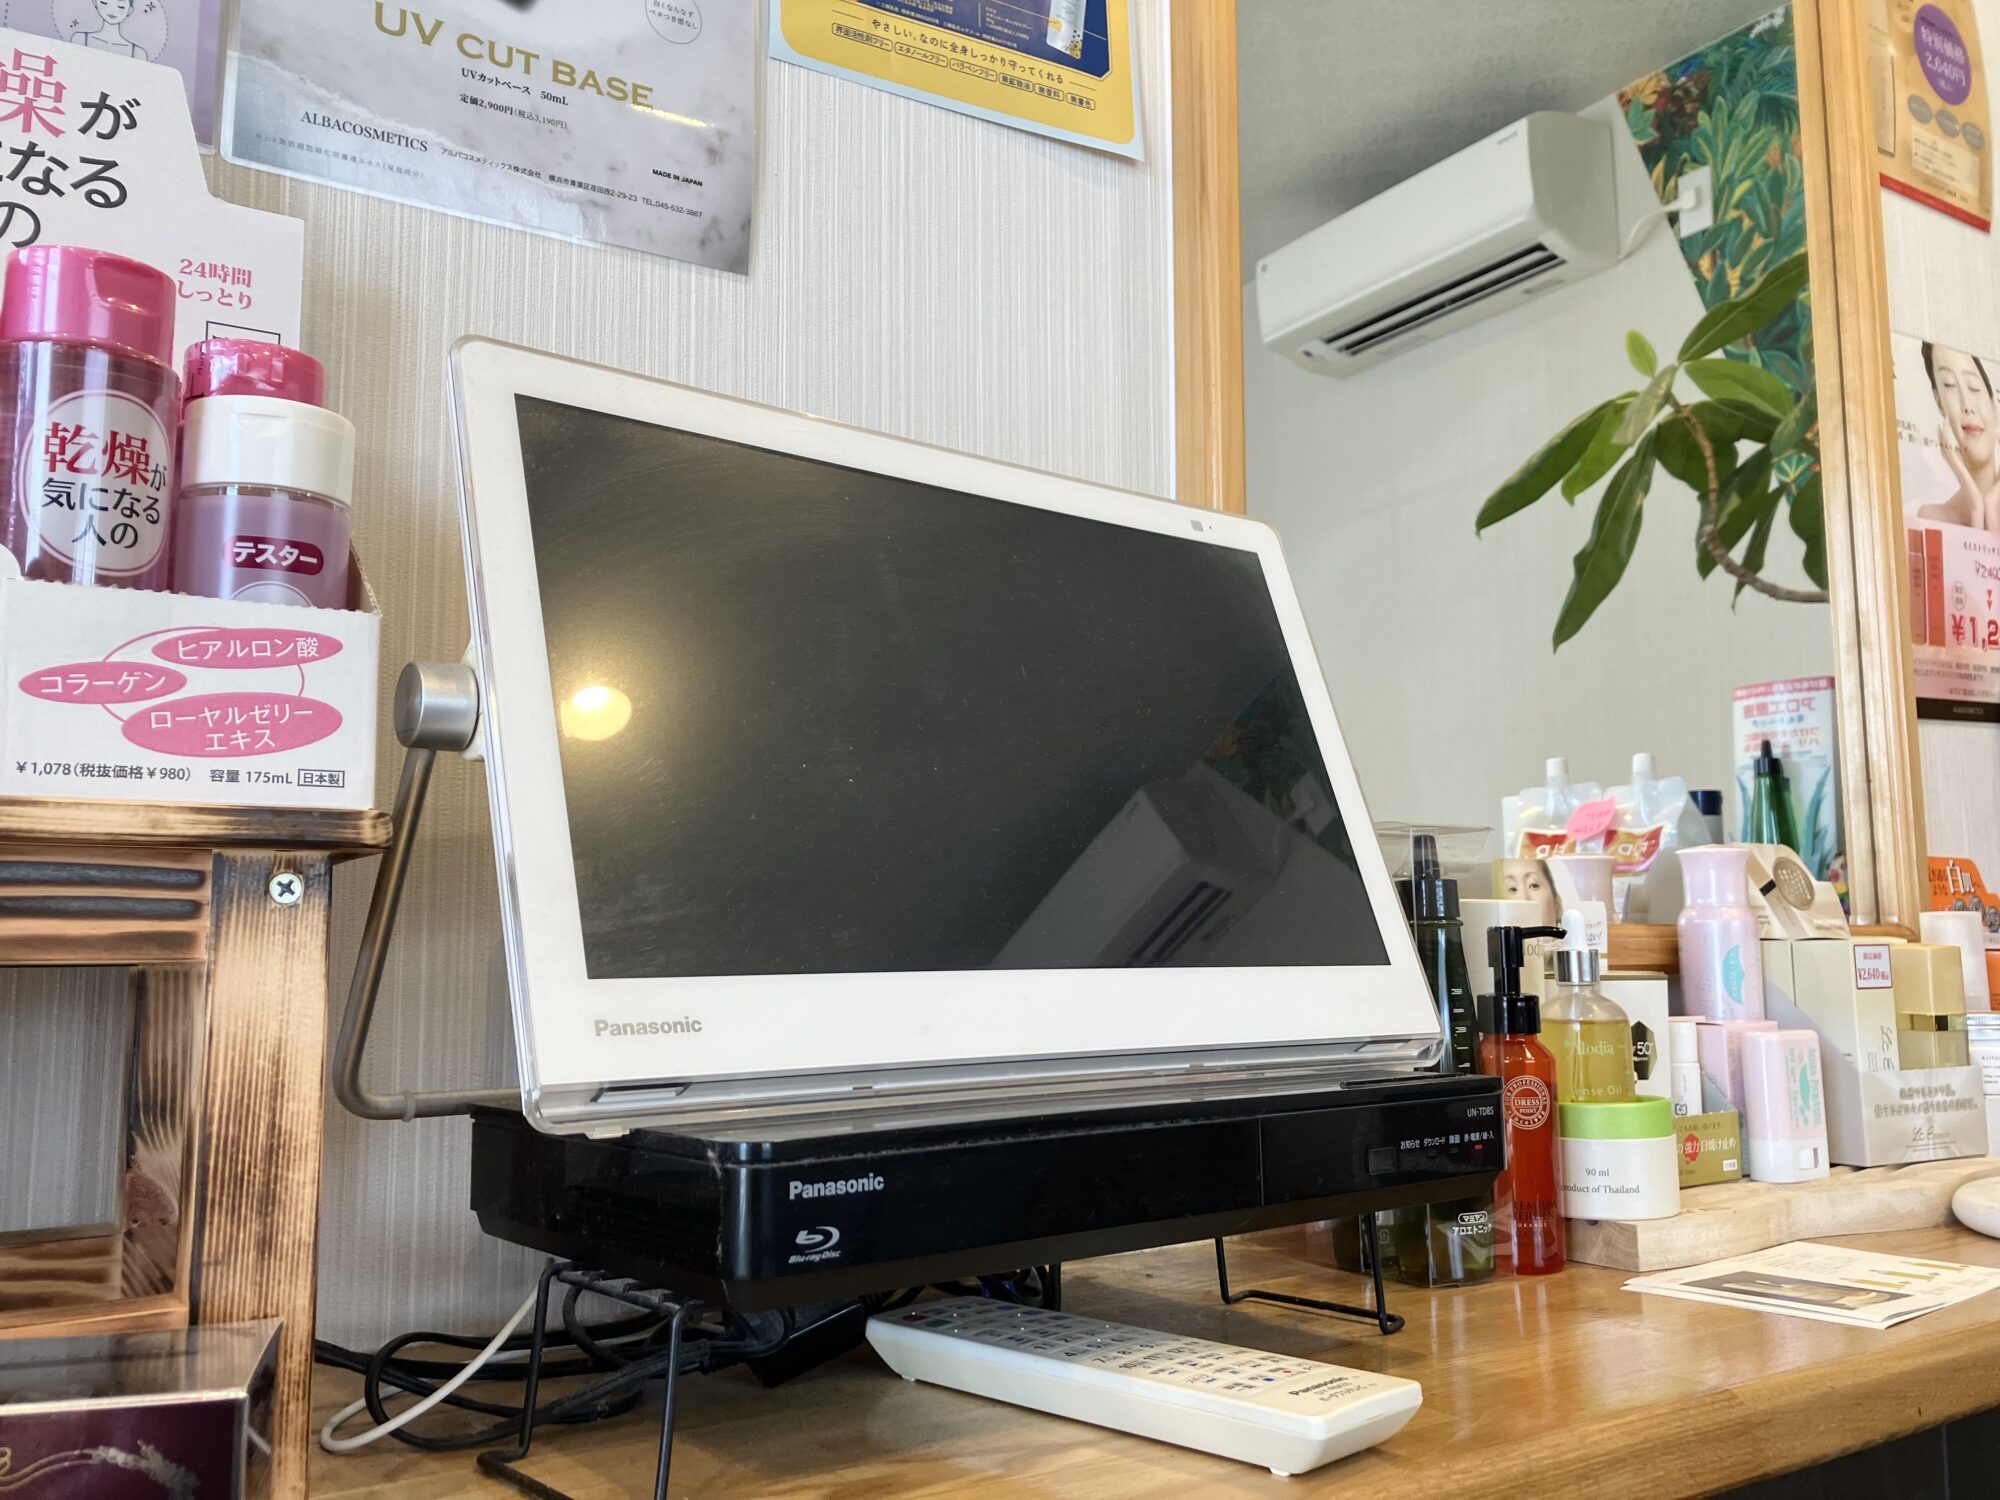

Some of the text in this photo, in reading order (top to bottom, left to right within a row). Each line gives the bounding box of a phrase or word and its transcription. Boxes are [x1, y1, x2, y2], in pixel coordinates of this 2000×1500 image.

[374, 0, 655, 110] UV CUT BASE
[872, 19, 1064, 84] やさしい、なのに全身しっかり守ってくれる
[897, 45, 946, 64] エタノールフリー
[461, 68, 569, 106] UVカットベース 50mL
[300, 111, 428, 152] ALBACOSMETICS
[0, 140, 128, 208] なる
[441, 148, 542, 179] アルバコスメティックス株式会社
[652, 169, 672, 179] MADE
[681, 176, 703, 187] JAPAN
[179, 258, 252, 288] 24時間
[176, 280, 252, 310] しっとり
[43, 423, 168, 491] 乾燥が
[41, 478, 162, 525] 気になる
[72, 515, 139, 549] 人の
[233, 541, 318, 567] テスター
[177, 636, 320, 660] ヒアルロン酸
[40, 671, 167, 694] コラーゲン
[151, 705, 313, 728] ローヤルゼリー
[205, 730, 276, 752] エキス
[210, 768, 240, 784] 容量
[246, 769, 293, 784] 175mL
[302, 772, 341, 786] 日本製
[594, 1016, 703, 1037] Panasonic
[1400, 1140, 1420, 1150] お知らせ
[1423, 1137, 1446, 1147] ダウンロード
[1585, 1168, 1609, 1176] 90 ml
[789, 1173, 885, 1200] Panasonic
[1560, 1184, 1640, 1194] roduct of Thailand
[1452, 1223, 1492, 1237] アロエトニック
[788, 1249, 842, 1264] Blu-ray Disc
[1289, 1376, 1348, 1396] Panasonic
